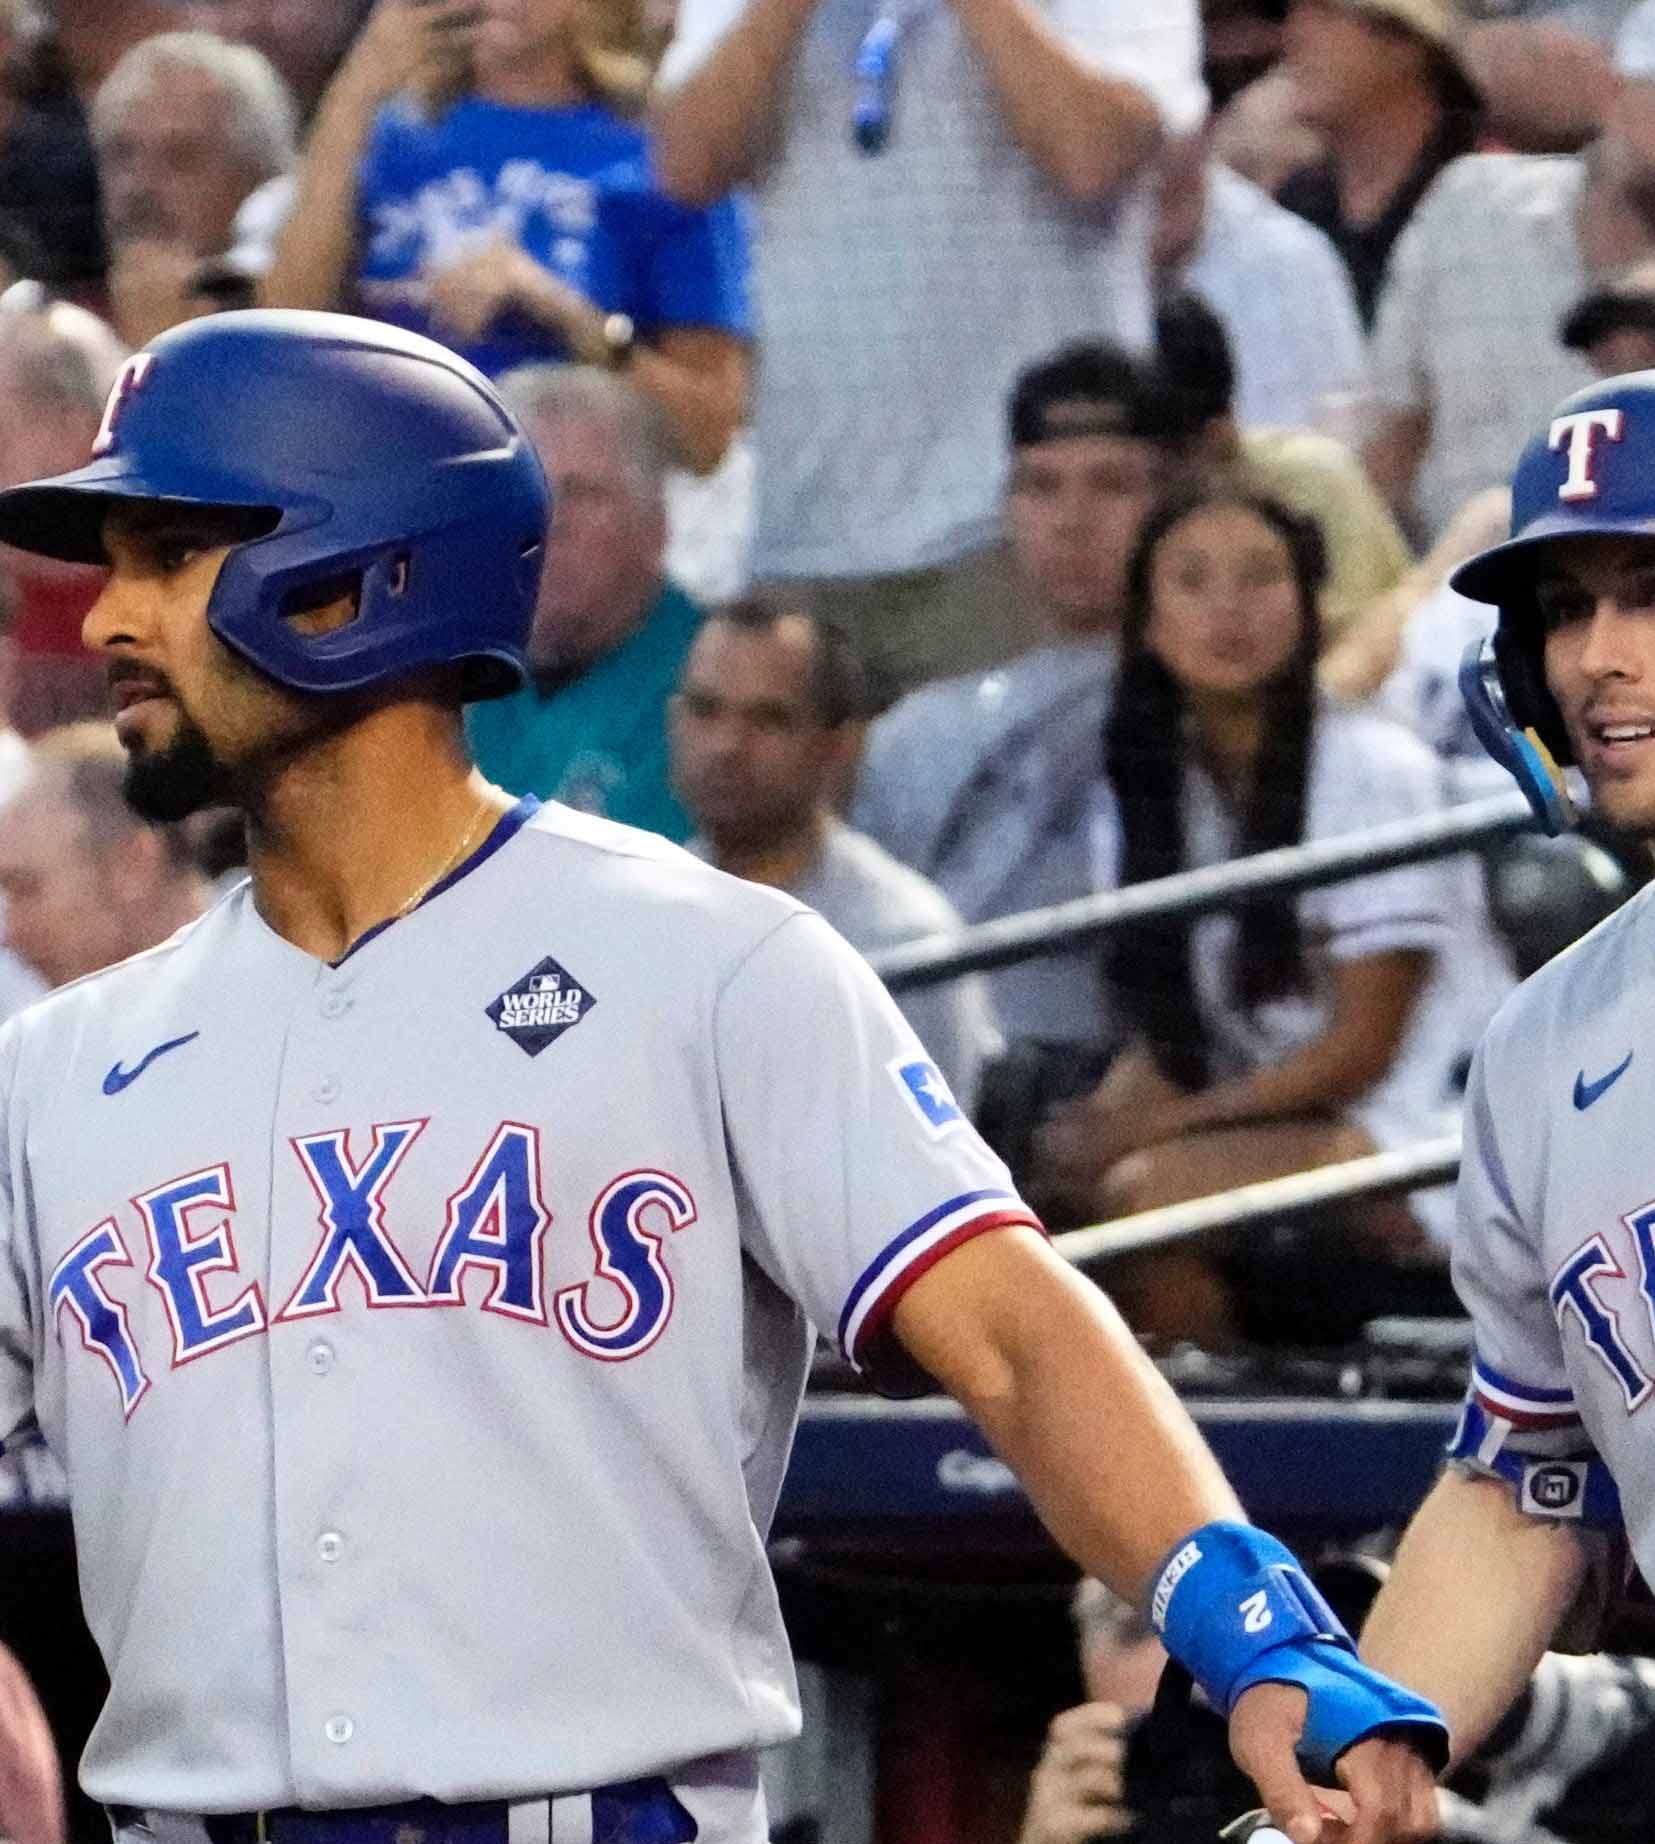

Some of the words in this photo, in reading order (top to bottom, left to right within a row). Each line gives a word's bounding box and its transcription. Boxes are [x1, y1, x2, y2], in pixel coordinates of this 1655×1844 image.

[1548, 408, 1625, 502] T
[499, 1004, 579, 1029] SERIES
[501, 988, 582, 1012] WORLD
[49, 1116, 698, 1426] TEXAS
